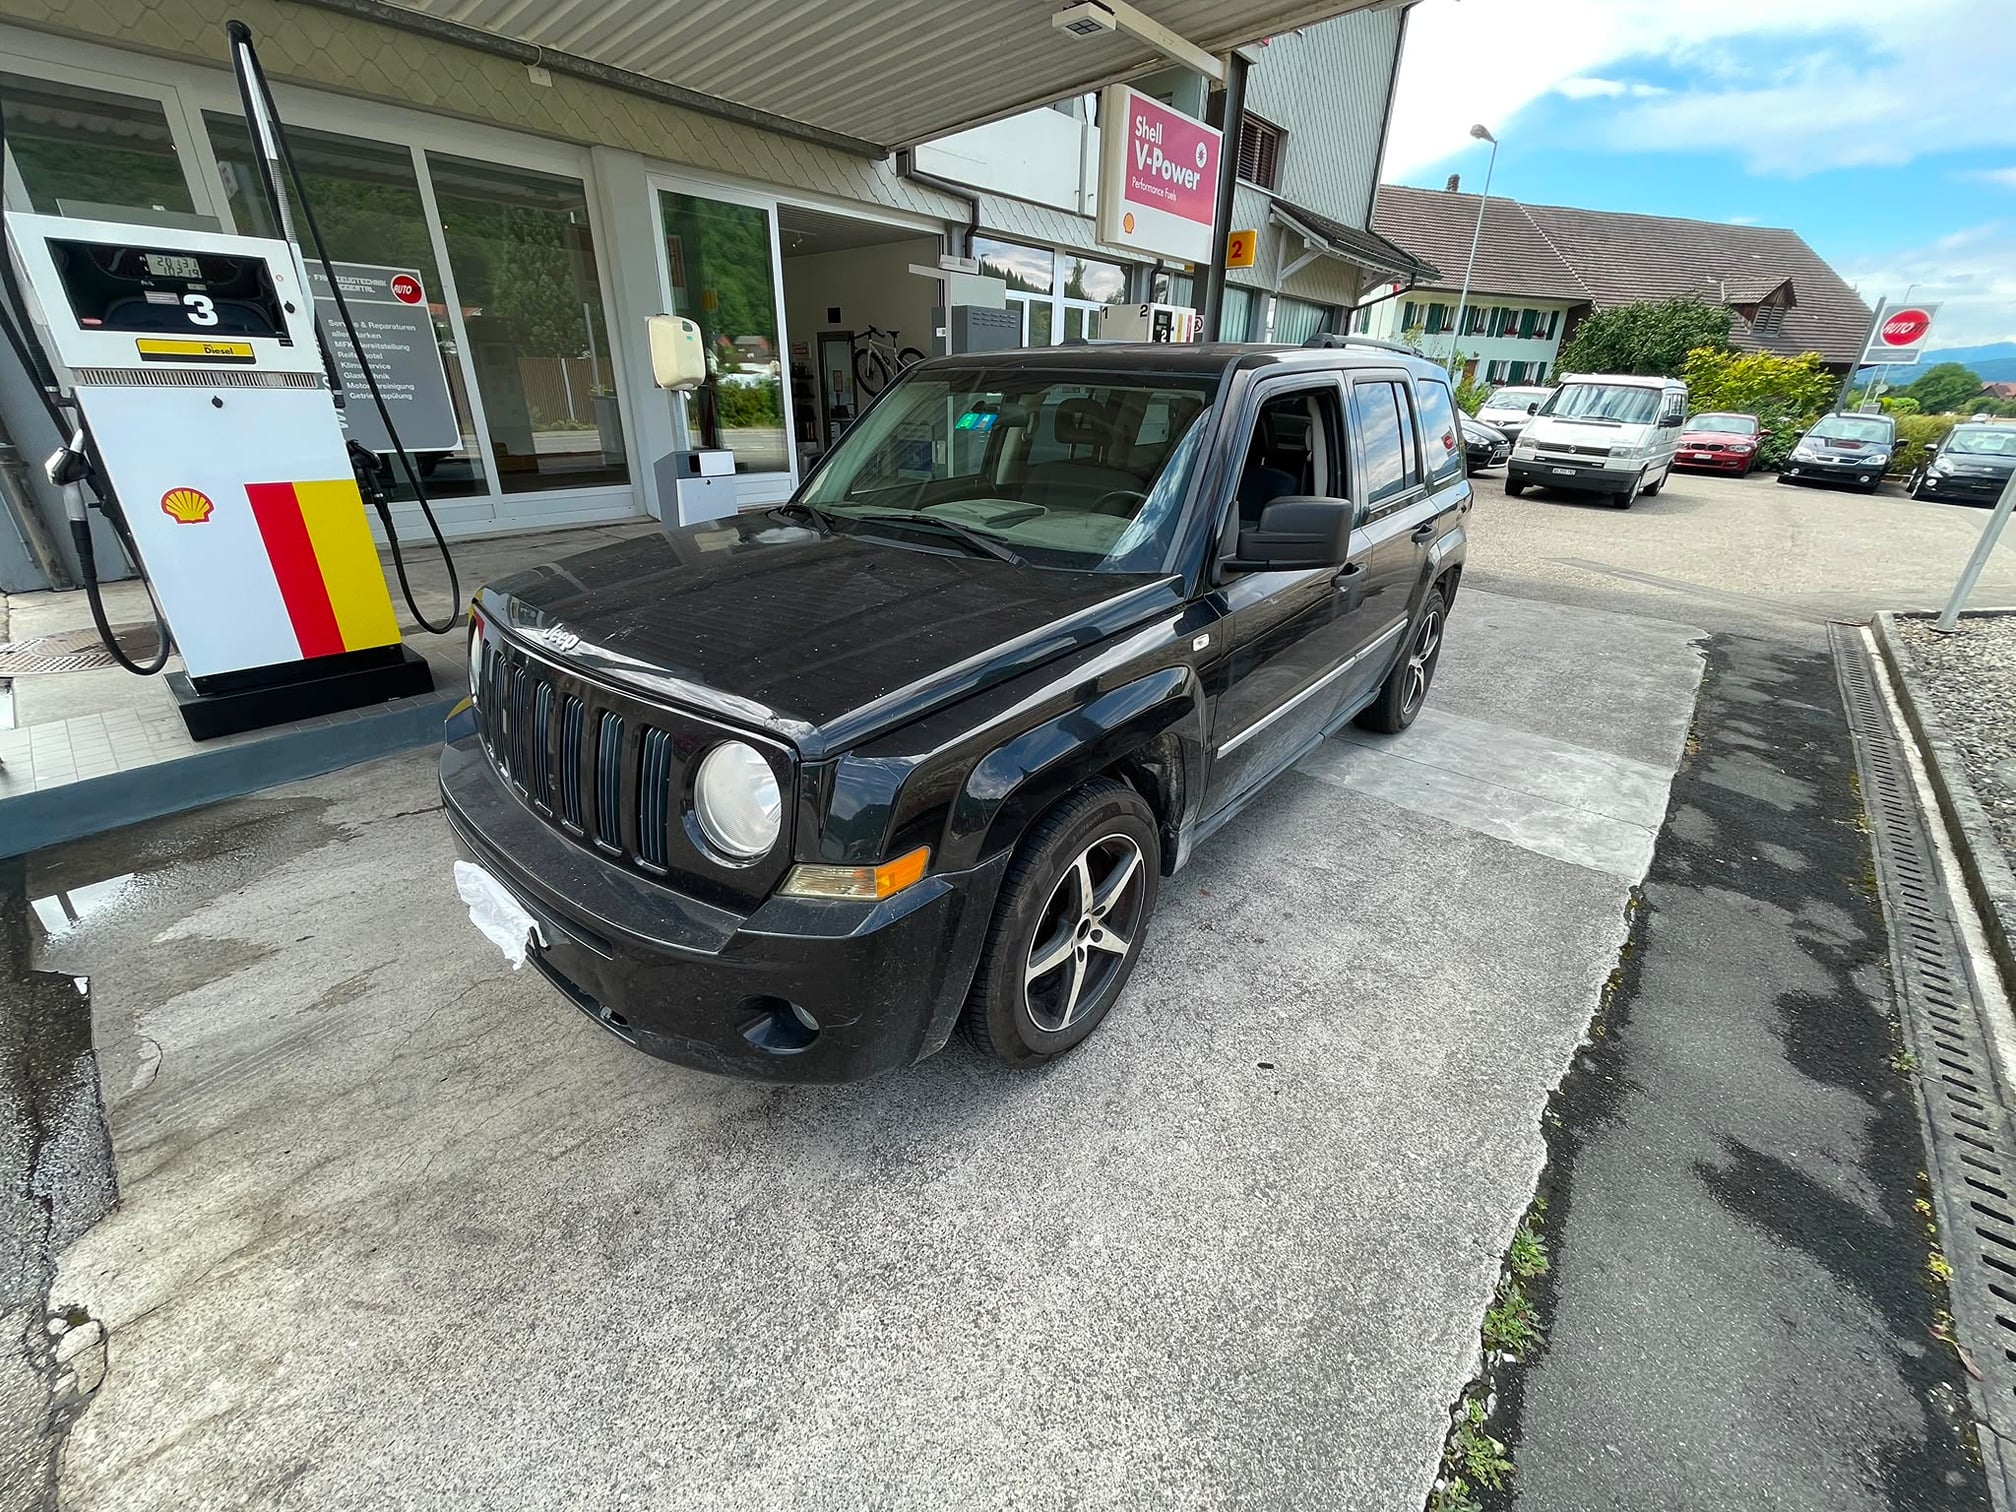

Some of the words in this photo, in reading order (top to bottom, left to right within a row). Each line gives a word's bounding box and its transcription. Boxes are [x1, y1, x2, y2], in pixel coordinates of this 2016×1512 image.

[1135, 115, 1163, 145] Shell
[1134, 139, 1201, 191] V-Power
[1131, 176, 1165, 198] Performance
[1164, 187, 1177, 202] Fuels
[1231, 240, 1243, 259] 2
[183, 293, 219, 326] 3
[1102, 306, 1108, 319] 1
[1139, 304, 1148, 317] 2
[355, 331, 382, 339] arken
[368, 321, 417, 331] Reparaturen
[1160, 329, 1168, 342] 2
[204, 346, 234, 355] Diesel
[542, 622, 580, 652] Jeep
